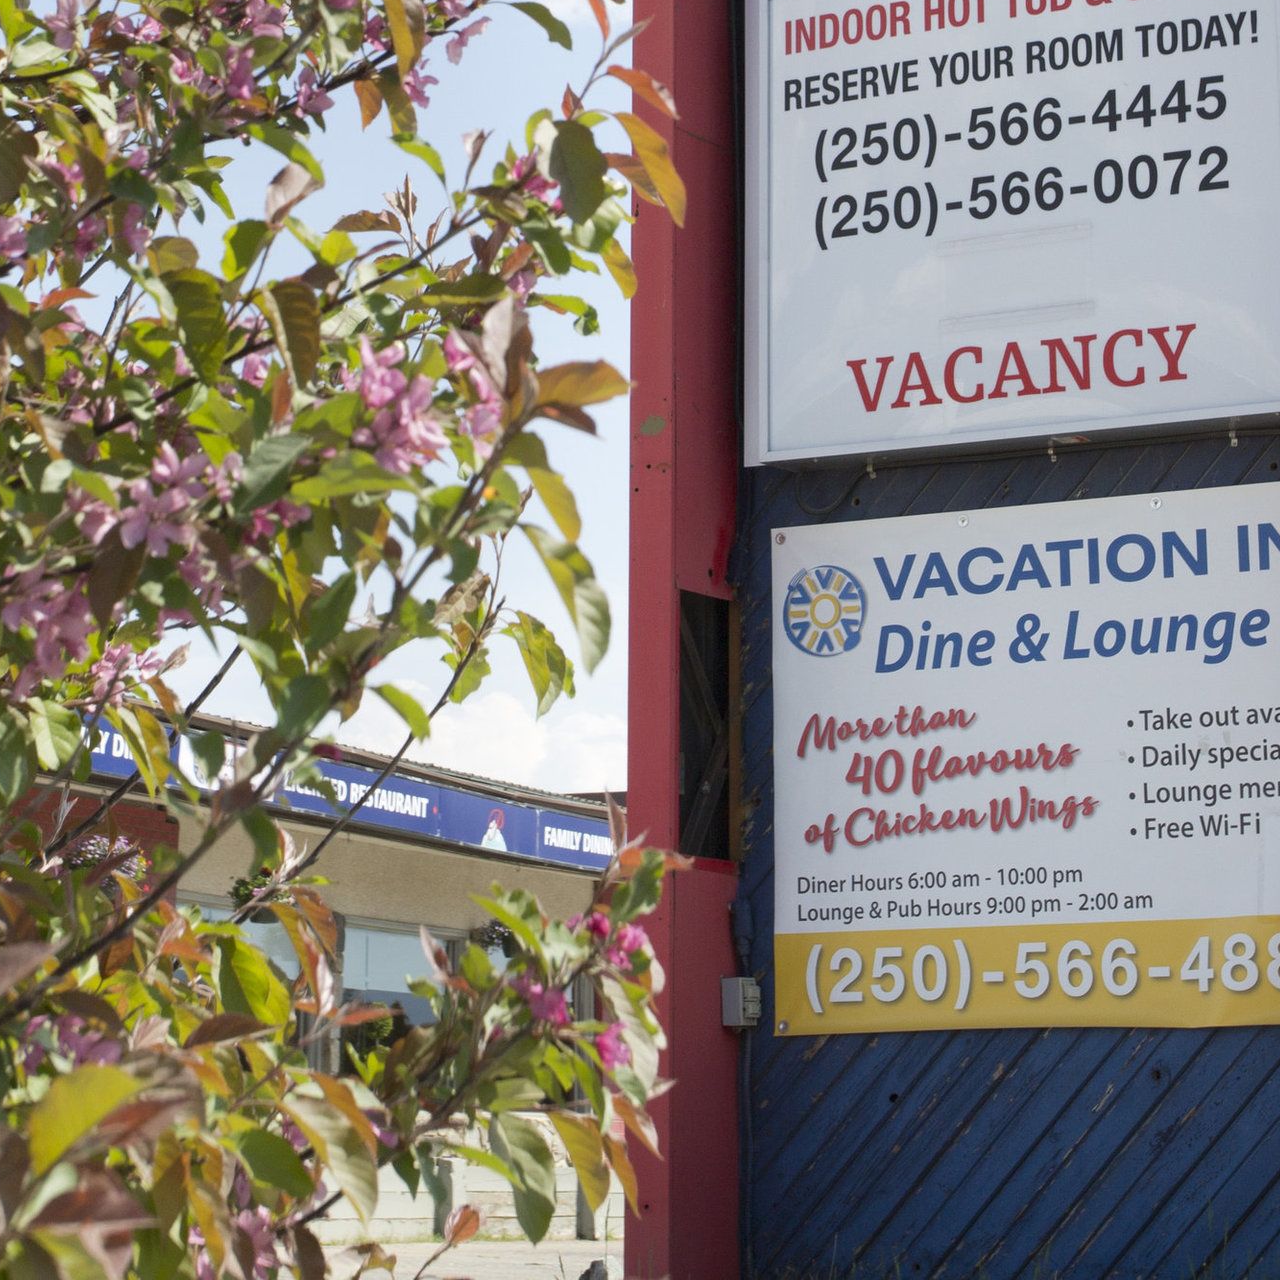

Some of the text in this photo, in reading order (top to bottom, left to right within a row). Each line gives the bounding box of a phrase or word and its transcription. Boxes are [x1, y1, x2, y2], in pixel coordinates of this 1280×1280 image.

[784, 1, 911, 55] INDOOR
[784, 10, 1259, 111] RESERVE YOUR ROOM TODAY!
[814, 74, 1228, 182] (250)-566-4445
[814, 145, 1230, 250] (250)-566-0072
[846, 323, 1197, 413] VACANCY
[873, 527, 1209, 601] VACATION
[874, 605, 1271, 674] Dine & Lounge
[796, 705, 976, 759] More than
[1139, 707, 1193, 731] Take
[1199, 705, 1240, 727] out
[845, 743, 1081, 796] 40 flavours
[1142, 743, 1201, 771] Daily
[349, 782, 430, 818] RESTAURANT
[804, 786, 1100, 854] of Chicken Wings
[1143, 782, 1232, 807] Lounge
[544, 826, 582, 851] FAMILY
[1144, 812, 1261, 840] Free Wi-Fi
[797, 876, 846, 895] Diner
[851, 873, 903, 892] Hours
[908, 871, 947, 889] 6:00
[952, 873, 980, 888] am
[997, 866, 1048, 886] 10:00
[1052, 868, 1083, 888] pm
[797, 904, 864, 925] Lounge
[869, 901, 882, 919] &
[887, 899, 922, 918] Pub
[927, 898, 981, 917] Hours
[987, 895, 1026, 915] 9:00
[1031, 897, 1061, 917] pm
[1078, 892, 1118, 911] 2:00
[1123, 895, 1153, 910] am
